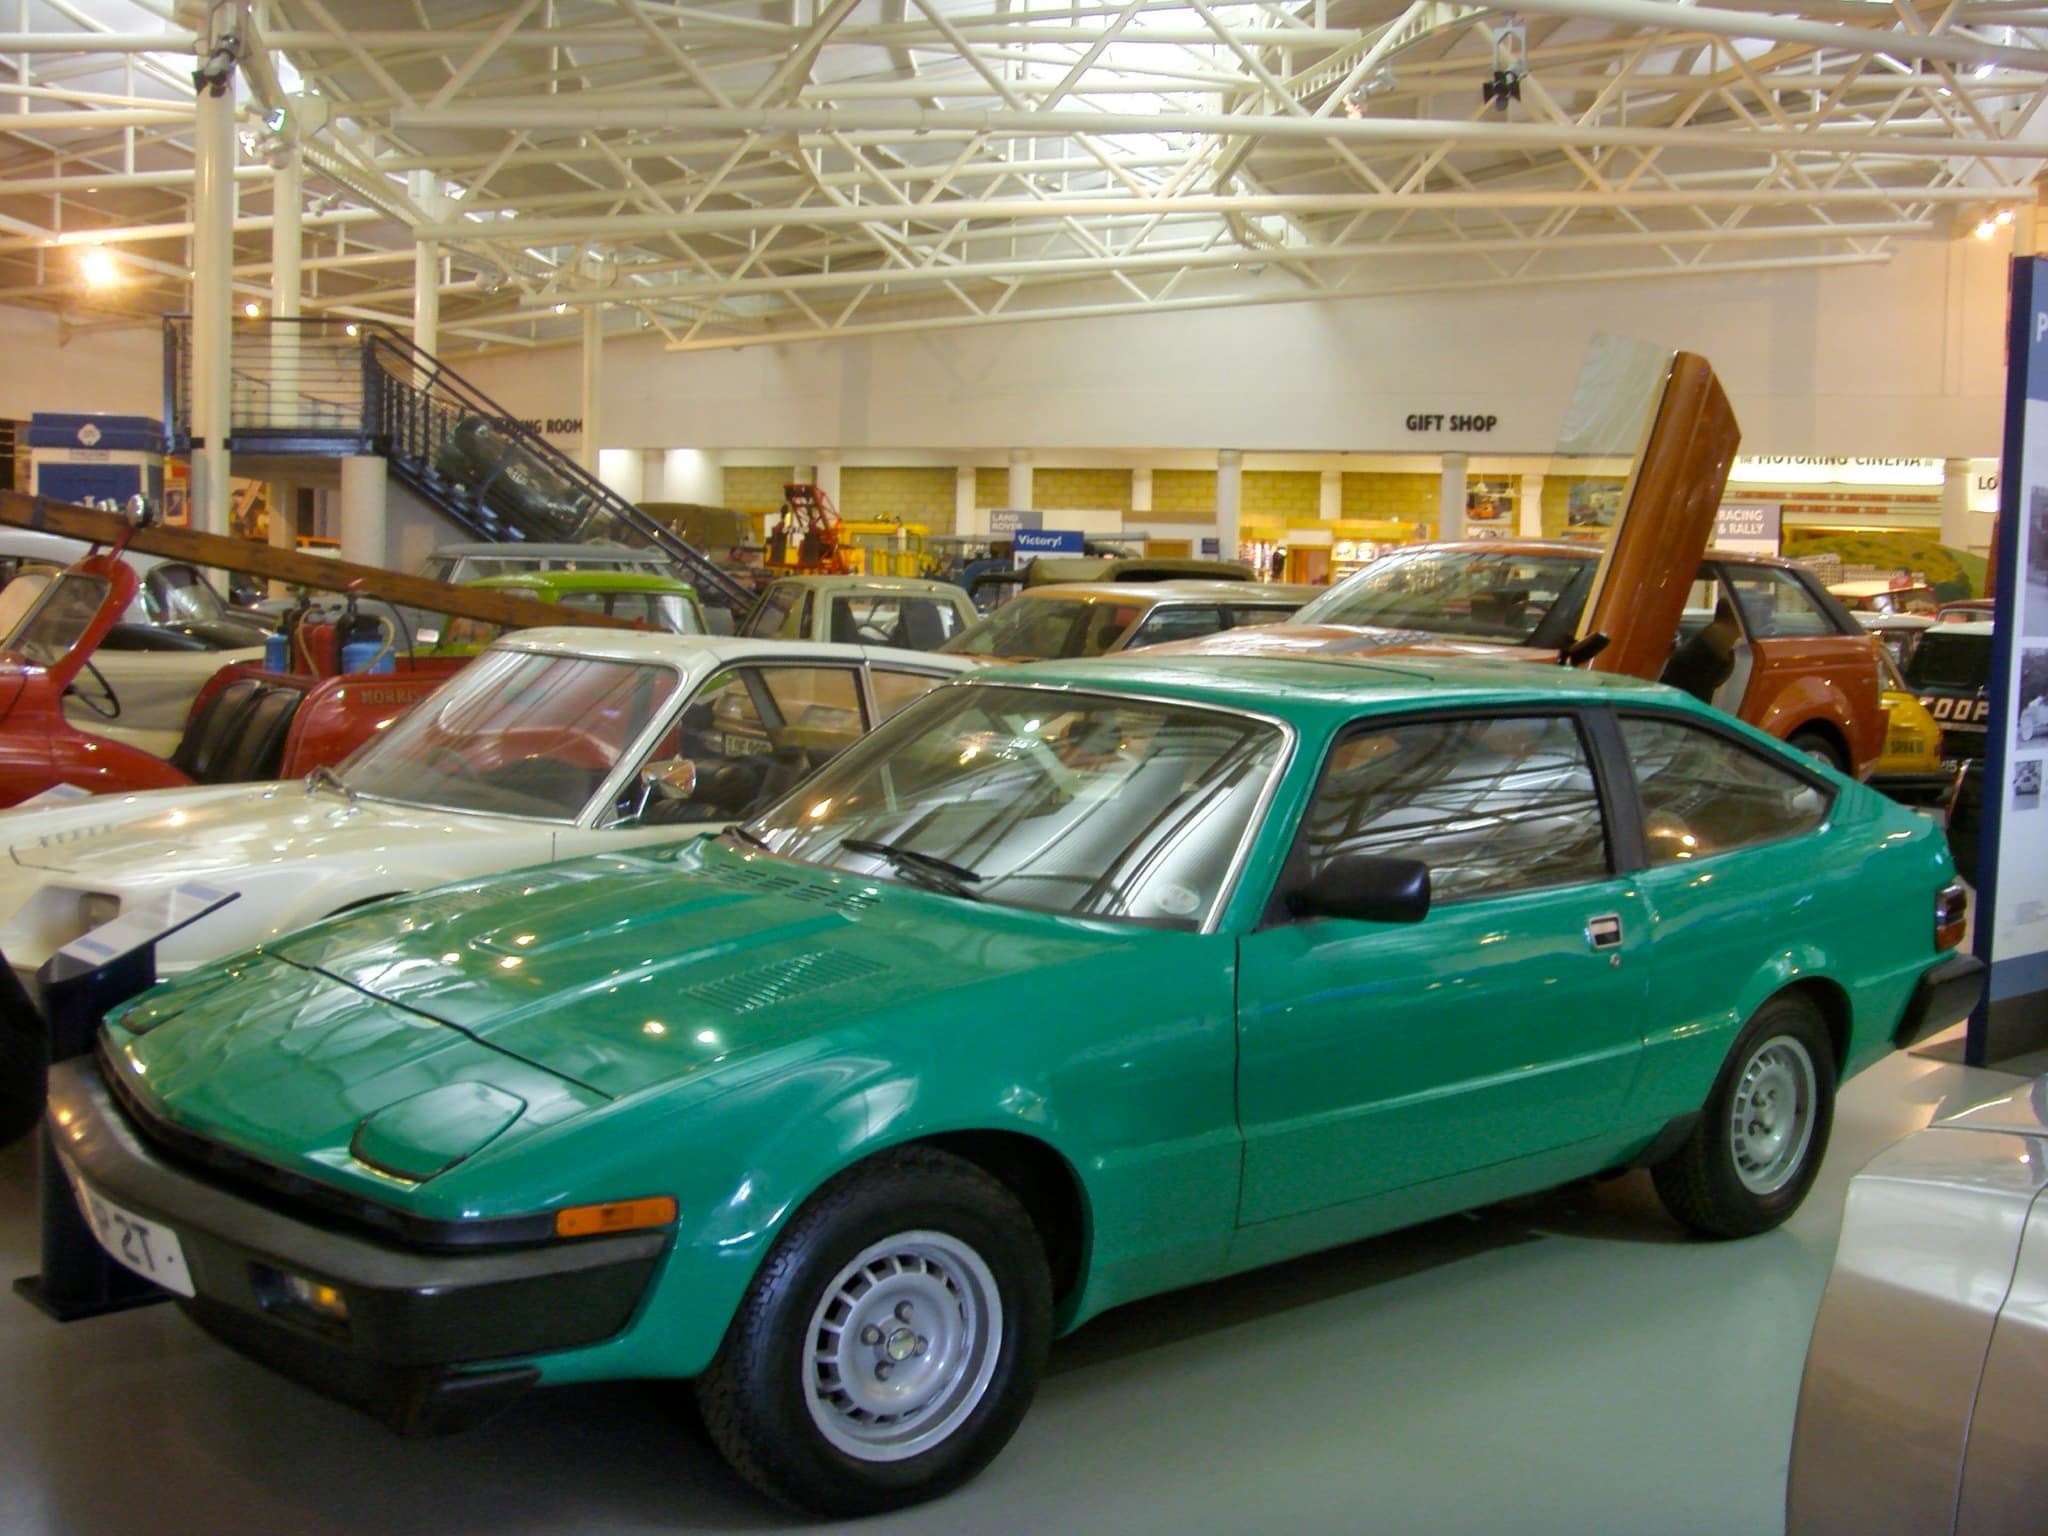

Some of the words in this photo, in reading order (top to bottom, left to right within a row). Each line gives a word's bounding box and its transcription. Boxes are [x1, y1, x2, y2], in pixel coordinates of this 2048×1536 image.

[546, 418, 583, 433] ROOM
[1406, 414, 1444, 431] GIFT
[1449, 414, 1498, 432] SHOP
[1719, 509, 1764, 521] RACING
[1729, 523, 1765, 534] RALLY
[1017, 534, 1063, 549] Victory!
